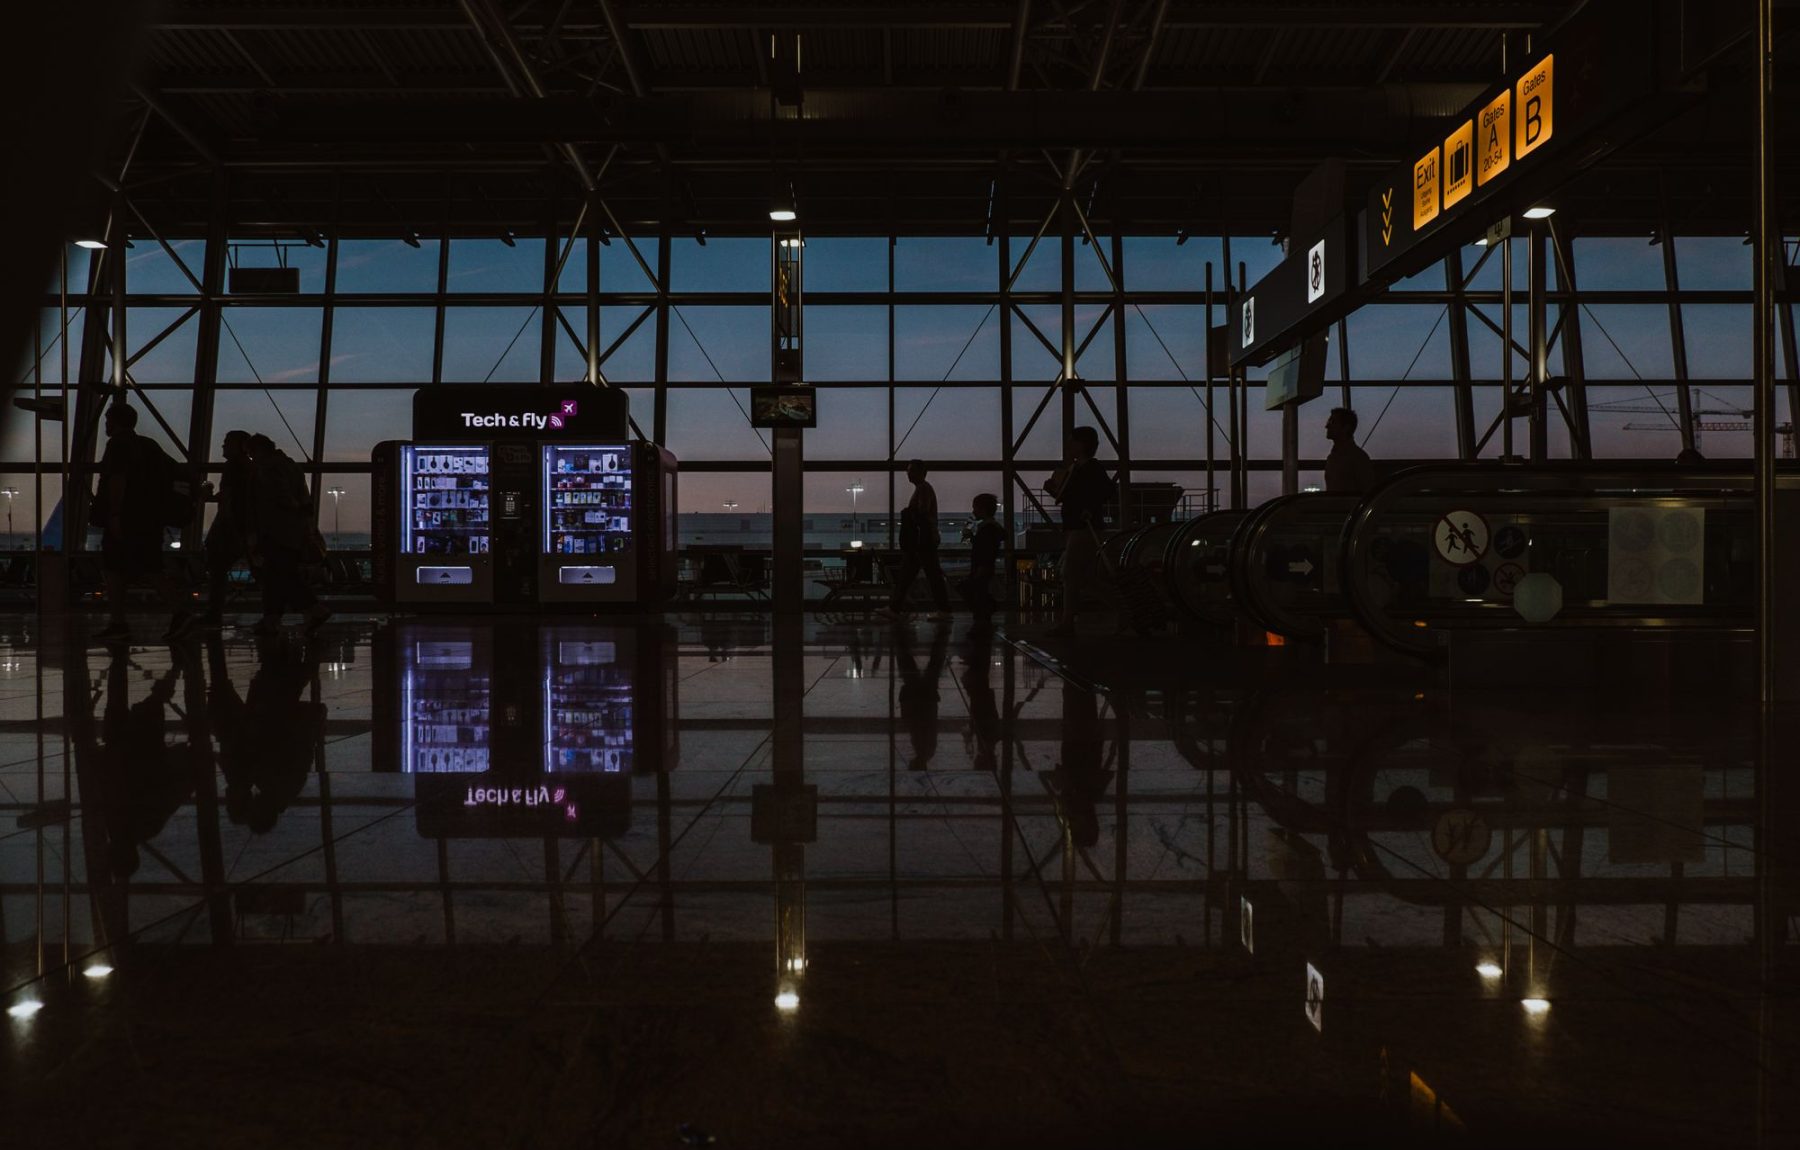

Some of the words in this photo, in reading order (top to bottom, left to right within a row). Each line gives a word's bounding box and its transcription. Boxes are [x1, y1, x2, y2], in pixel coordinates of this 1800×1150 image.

[1523, 71, 1546, 95] Gates
[1483, 103, 1504, 128] Gates
[1526, 95, 1541, 146] B
[1488, 124, 1498, 151] A
[1417, 157, 1435, 189] Exit
[1483, 150, 1503, 172] 20-54
[461, 412, 506, 427] Tech
[509, 415, 520, 427] &
